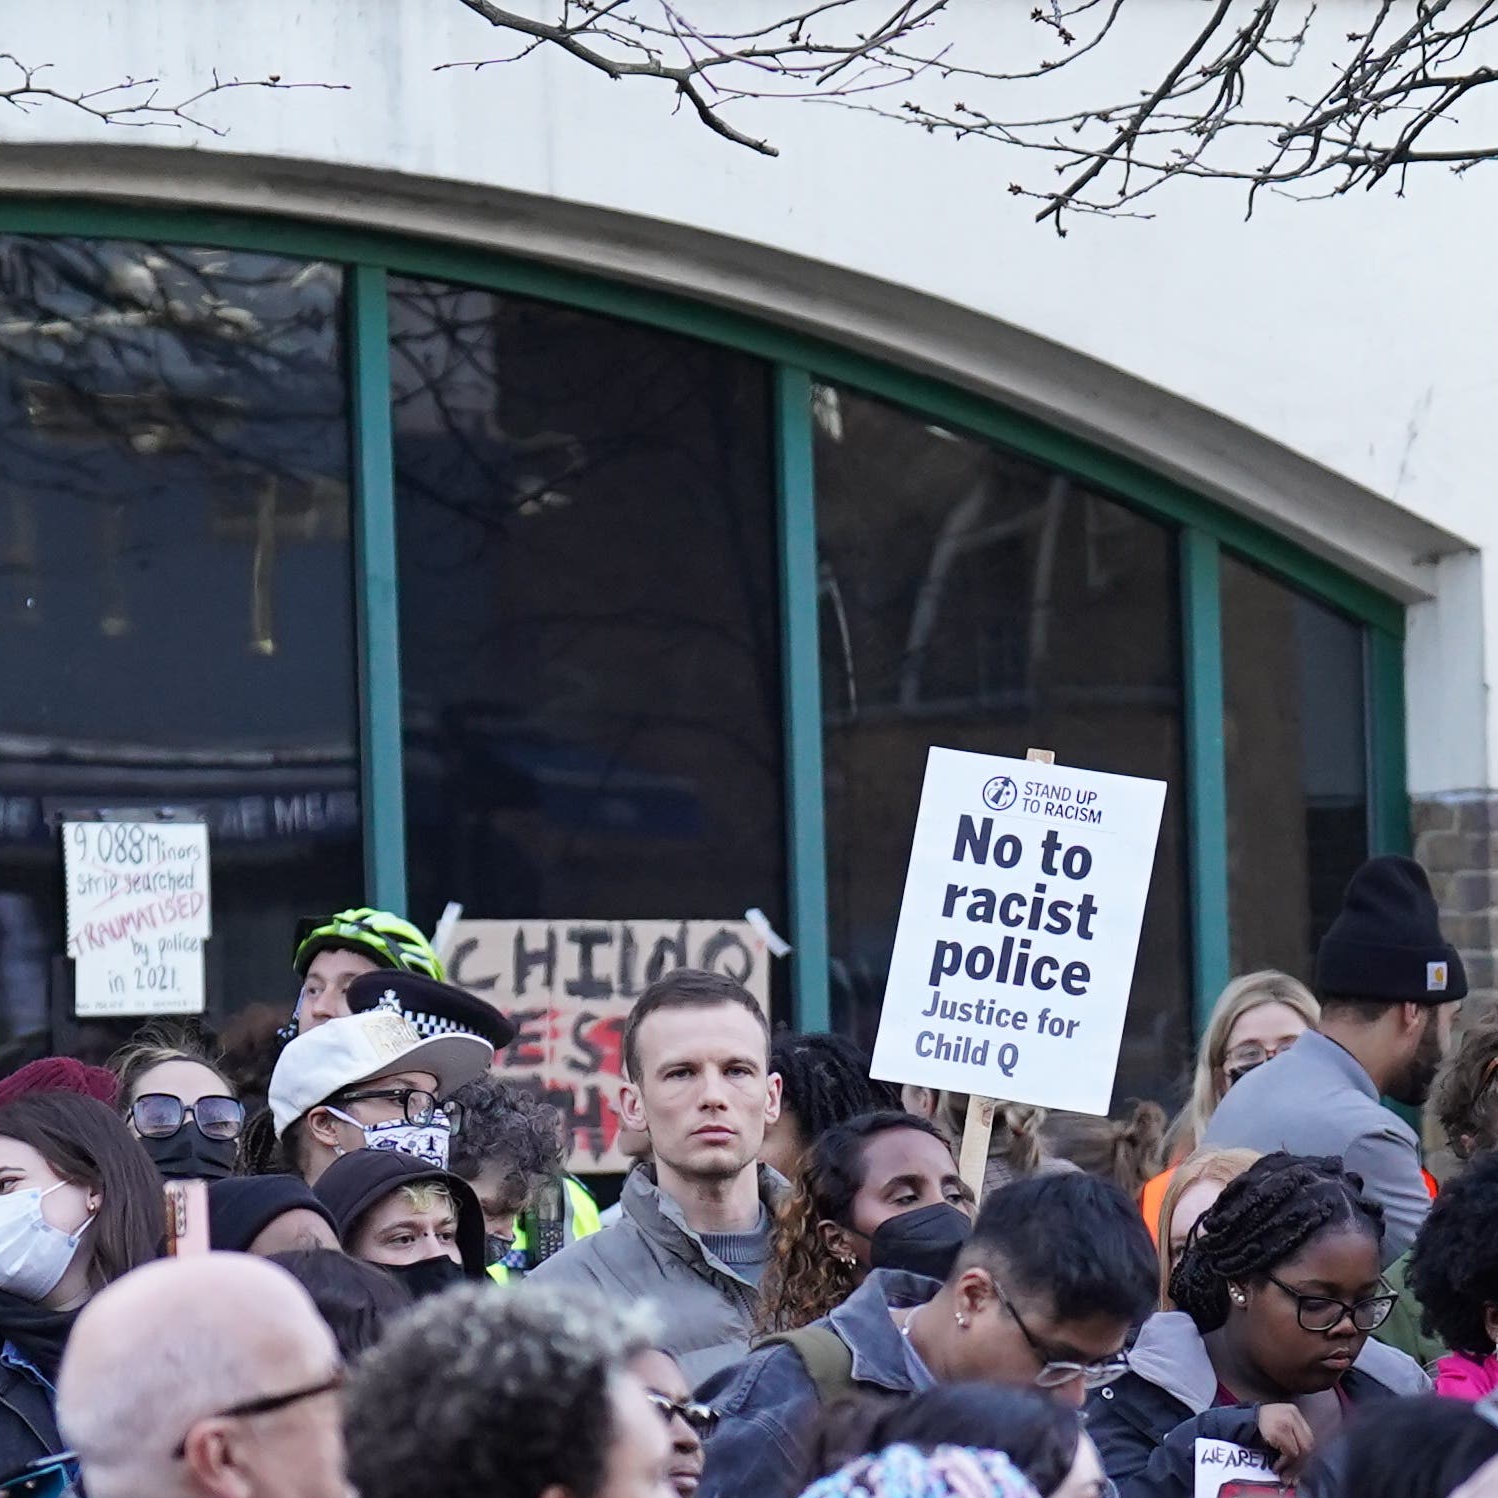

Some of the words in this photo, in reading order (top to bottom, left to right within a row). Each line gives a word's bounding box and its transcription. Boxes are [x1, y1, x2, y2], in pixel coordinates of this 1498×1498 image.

[1022, 798, 1042, 815] TO
[1044, 804, 1103, 825] RACISM
[1024, 781, 1072, 802] STAND
[1076, 790, 1098, 806] UP
[147, 833, 200, 862] Minors
[952, 814, 1023, 869] No
[1041, 830, 1093, 881] to
[77, 873, 118, 899] strip
[125, 869, 194, 897] searched
[68, 892, 204, 956] TRAUMATISED
[942, 883, 1098, 941] racist
[131, 936, 149, 966] by
[158, 932, 200, 959] police
[928, 936, 1091, 996] police
[107, 971, 125, 993] in
[922, 991, 1028, 1031] Justice
[1037, 1008, 1081, 1039] for
[915, 1030, 990, 1067] Child
[997, 1043, 1019, 1078] Q
